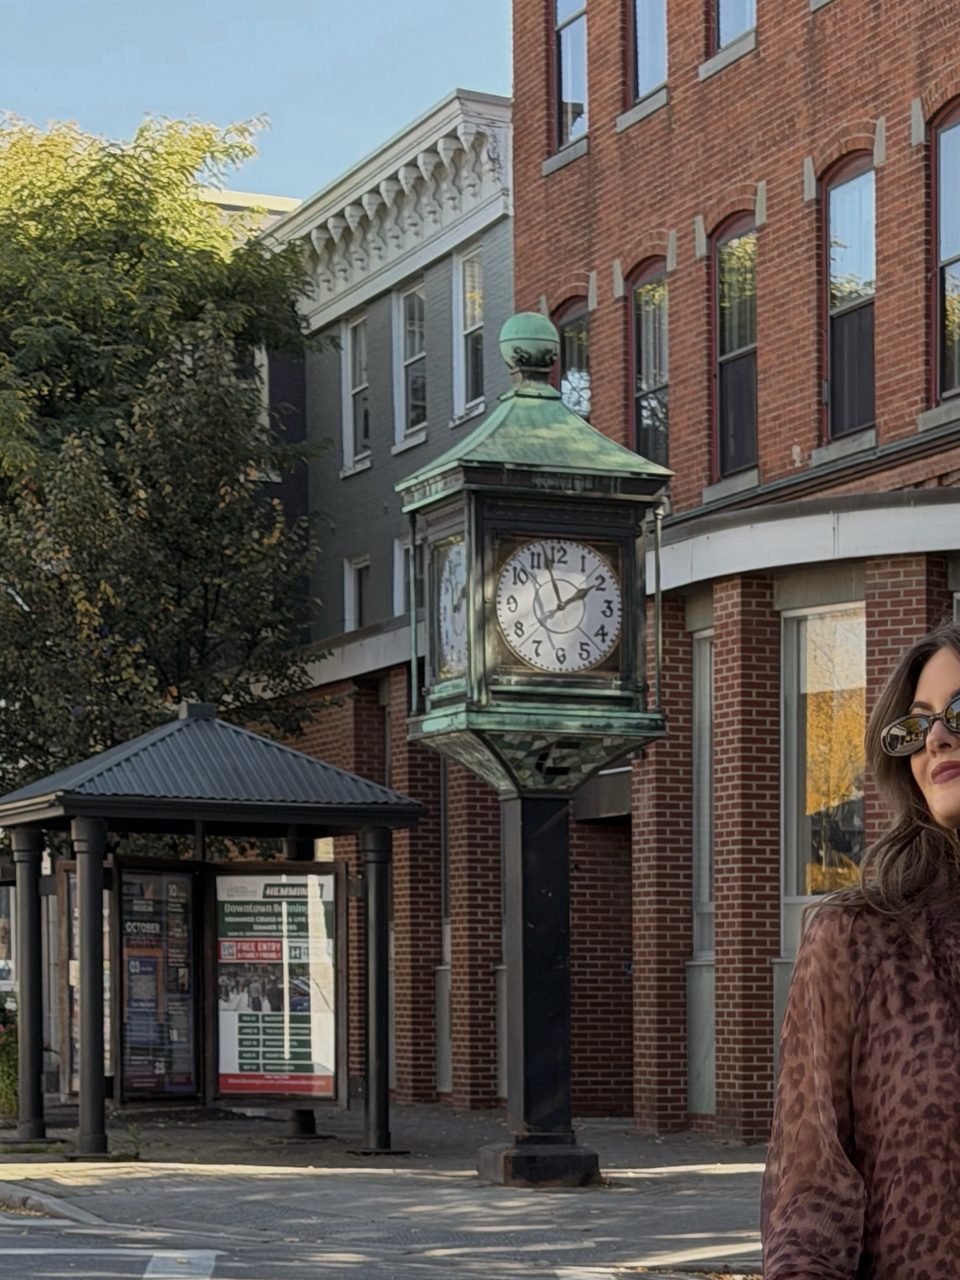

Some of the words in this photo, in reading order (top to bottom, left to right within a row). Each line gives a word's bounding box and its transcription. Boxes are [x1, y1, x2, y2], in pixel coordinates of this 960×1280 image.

[530, 551, 541, 570] 11
[512, 566, 529, 586] 10
[595, 574, 606, 592] 2
[506, 594, 518, 613] 9
[601, 599, 613, 618] 3
[514, 620, 525, 638] 8
[594, 624, 608, 643] 4
[531, 639, 543, 657] 7
[555, 647, 566, 665] 6
[578, 642, 590, 661] 5
